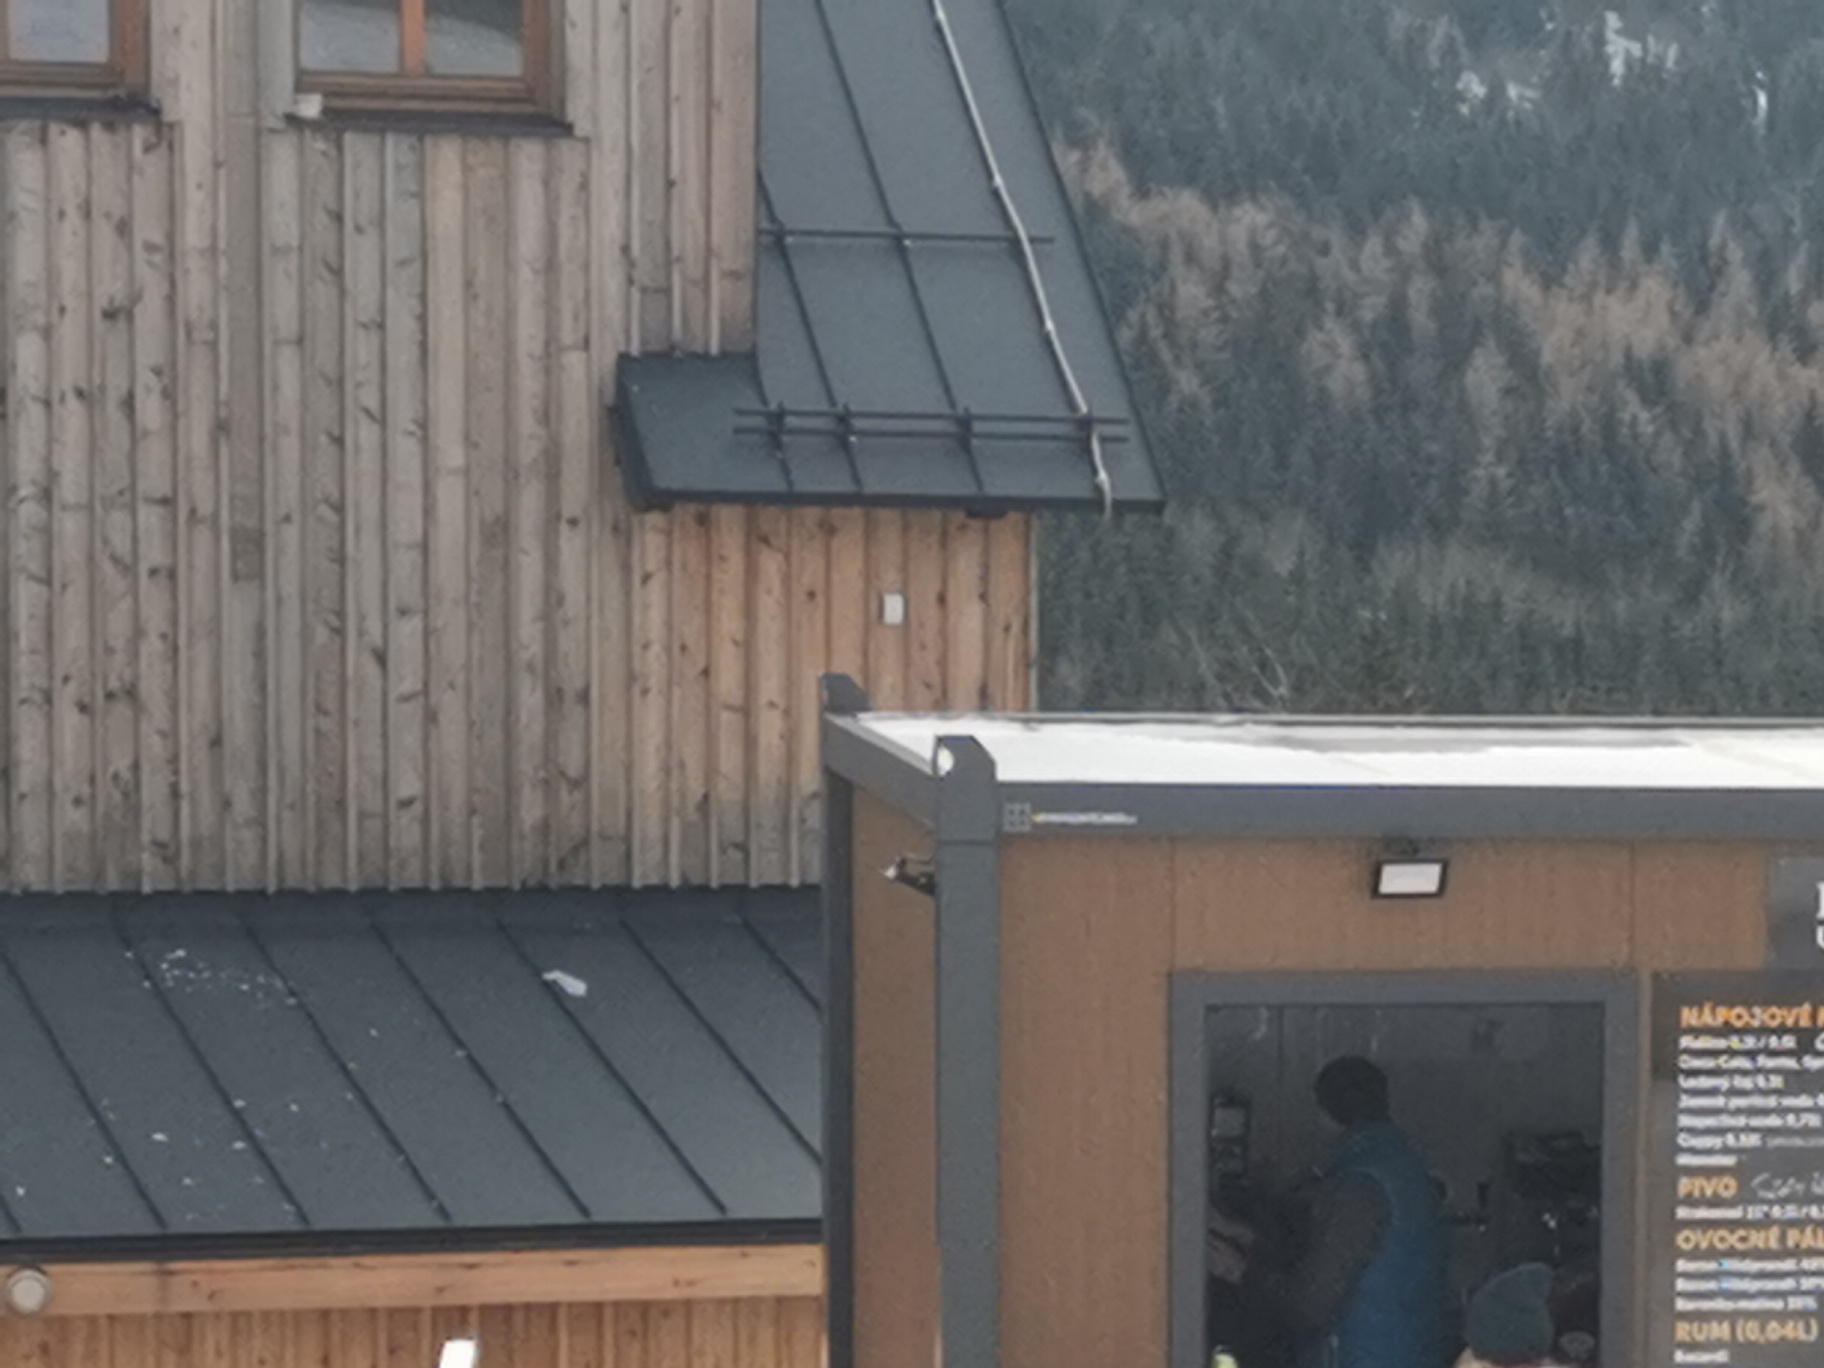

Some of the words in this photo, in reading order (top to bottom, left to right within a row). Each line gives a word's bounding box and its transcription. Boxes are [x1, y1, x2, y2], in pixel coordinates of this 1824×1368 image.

[1680, 1003, 1812, 1027] NÁPOJOVÉ
[1677, 1177, 1738, 1198] PIVO
[1676, 1227, 1780, 1250] OVOCNÉ
[1675, 1321, 1731, 1342] RUM
